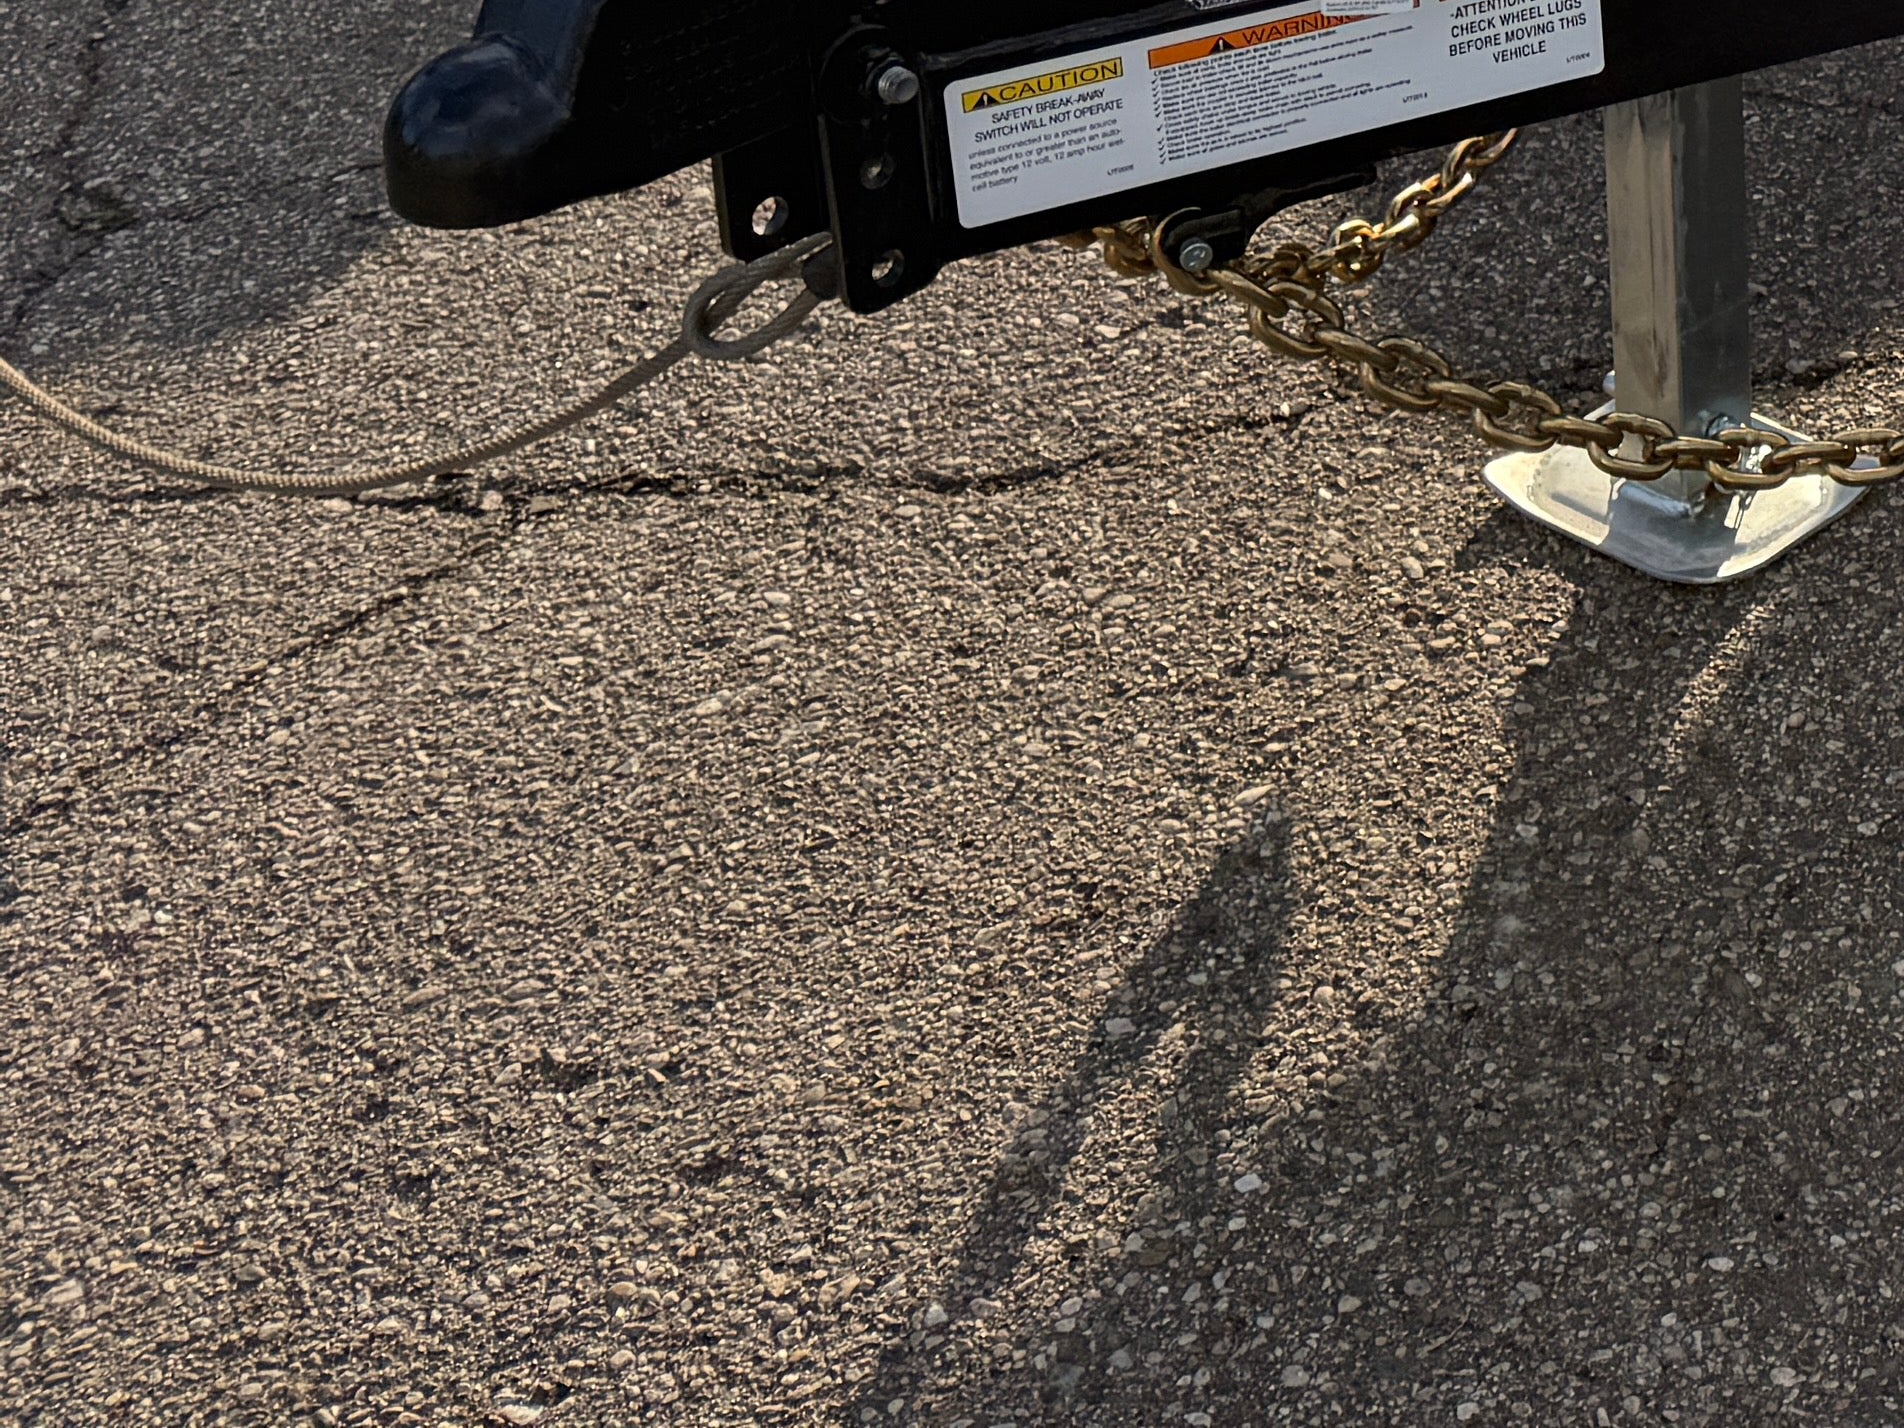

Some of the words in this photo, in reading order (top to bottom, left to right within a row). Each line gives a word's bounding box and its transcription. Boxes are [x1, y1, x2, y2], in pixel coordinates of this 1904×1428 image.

[1449, 33, 1502, 57] BEFORE
[1505, 20, 1556, 44] MOVING
[1558, 12, 1587, 31] THIS
[1451, 17, 1497, 39] CHECK
[1499, 5, 1545, 27] WHEEL
[1492, 40, 1547, 64] VEHICLE
[999, 61, 1118, 101] CAUTION
[974, 124, 1020, 143] SWITCH
[1019, 119, 1048, 136] WILL
[1049, 110, 1073, 126] NOT
[1073, 98, 1124, 120] OPERATE
[991, 106, 1033, 124] SAFETY
[1035, 88, 1106, 114] BREAK-AWAY
[968, 147, 996, 161] unless
[997, 135, 1043, 153] connected
[1043, 133, 1053, 142] to
[1061, 125, 1089, 139] power
[1088, 118, 1118, 131] source
[969, 153, 1014, 171] equivalent
[1014, 151, 1024, 160] to
[1024, 149, 1034, 158] or
[1035, 140, 1067, 157] greater
[1067, 135, 1087, 147] than
[1088, 132, 1100, 142] an
[971, 167, 1000, 182] motive
[1001, 162, 1020, 176] type
[1021, 158, 1034, 169] 12
[1053, 151, 1066, 162] 12
[1066, 146, 1087, 161] amp
[1086, 141, 1106, 154] hour
[988, 175, 1019, 190] battery
